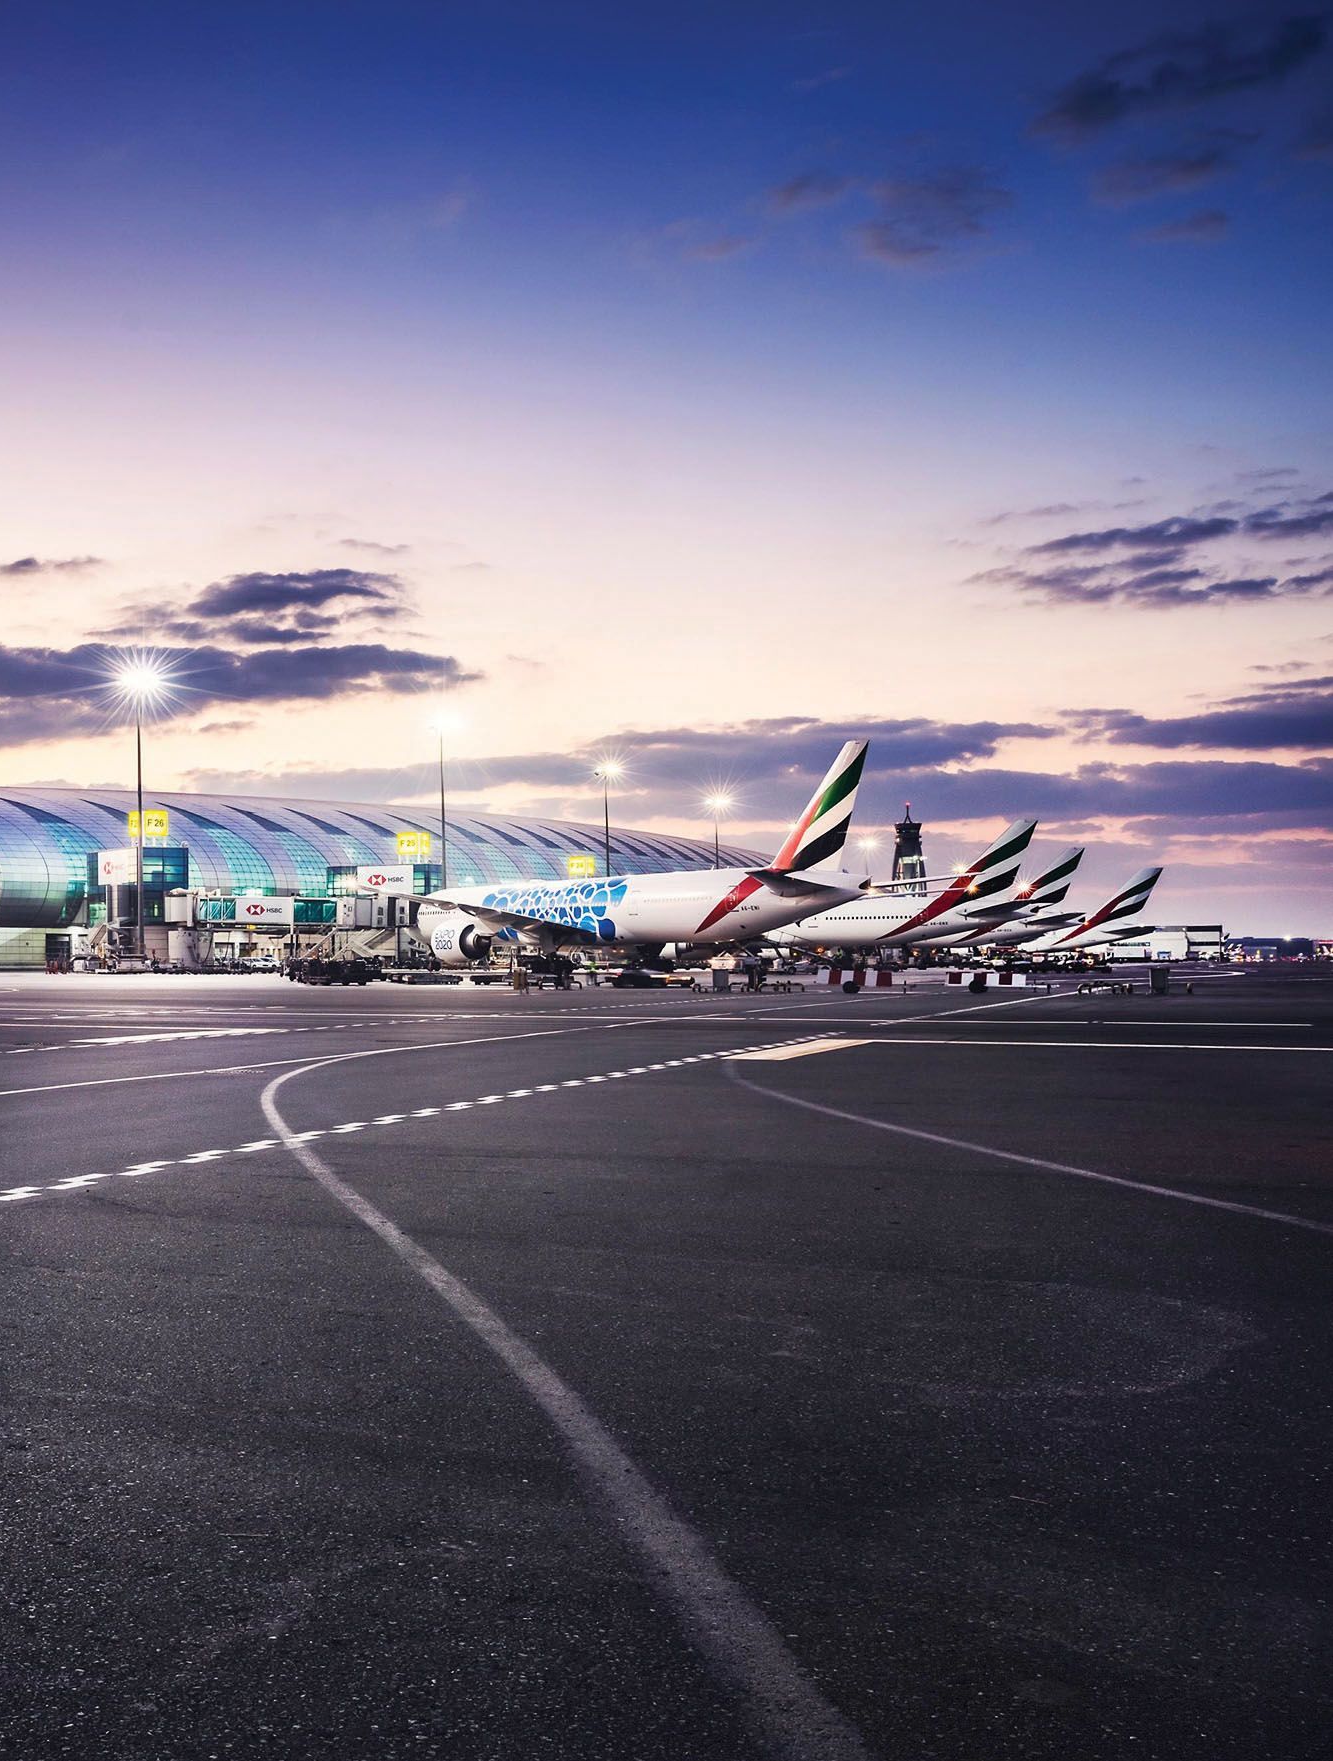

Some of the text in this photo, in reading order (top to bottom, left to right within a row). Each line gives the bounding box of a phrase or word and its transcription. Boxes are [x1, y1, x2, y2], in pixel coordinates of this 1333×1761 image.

[147, 818, 164, 828] F 26
[400, 839, 405, 847] F
[435, 929, 455, 940] EXPO
[435, 940, 453, 950] 2020
